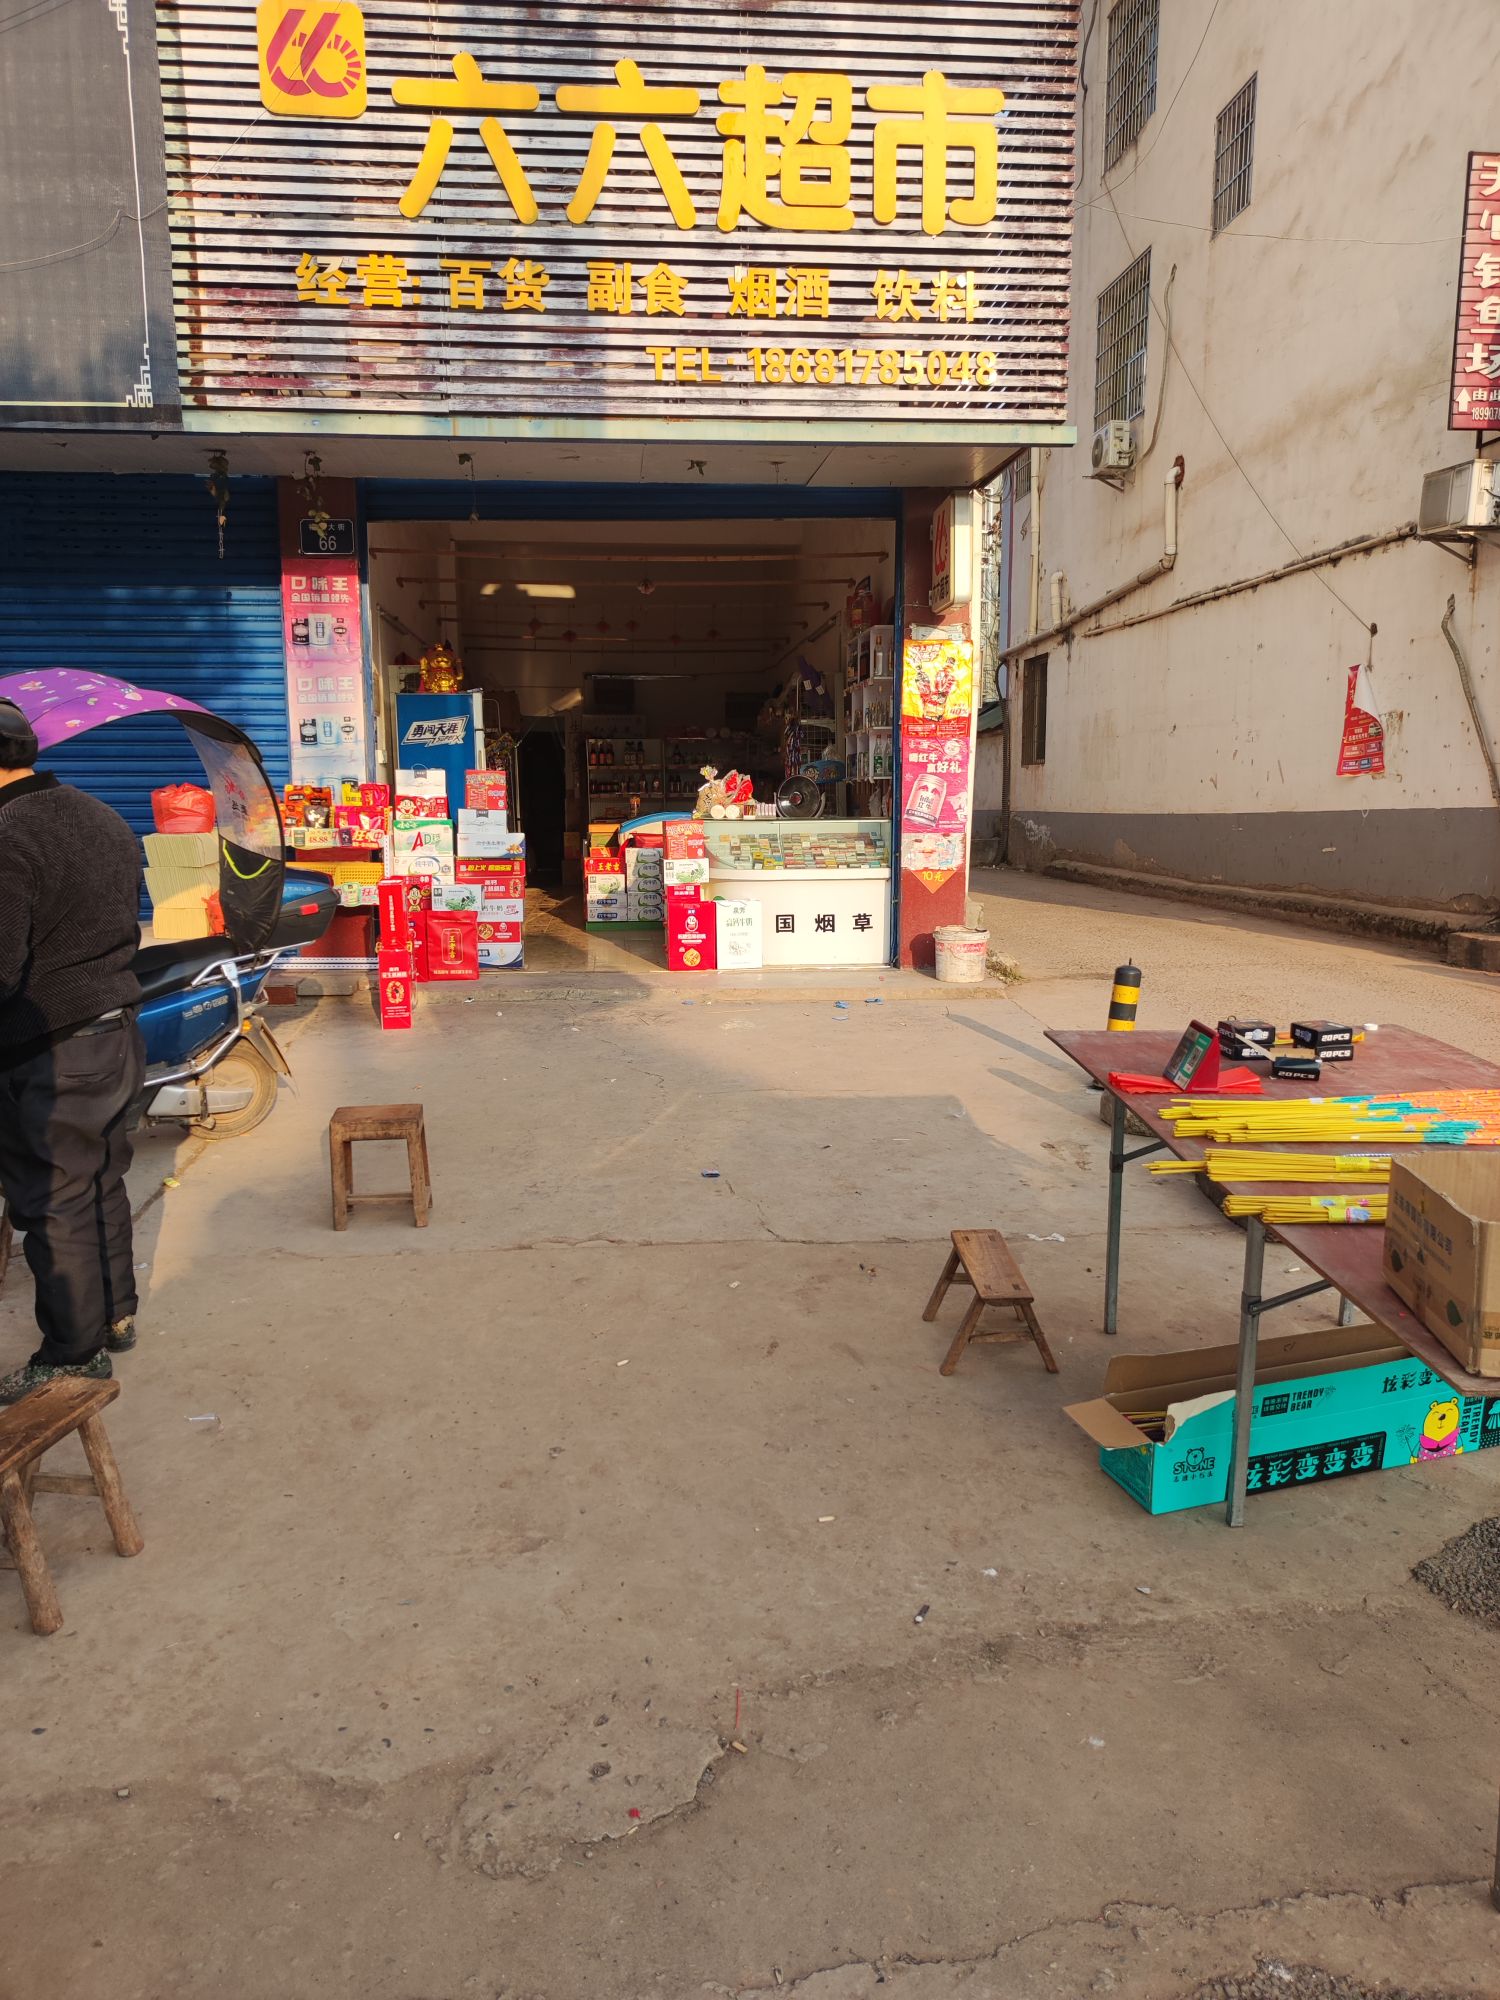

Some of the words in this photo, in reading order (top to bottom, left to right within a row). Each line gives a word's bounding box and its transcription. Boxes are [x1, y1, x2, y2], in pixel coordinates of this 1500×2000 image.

[391, 52, 1004, 236] 六六超市
[440, 257, 550, 313] 百货
[586, 261, 689, 317] 副食
[728, 265, 831, 320] 烟酒
[871, 269, 980, 323] 饮料
[747, 348, 998, 386] 18681785048
[319, 535, 337, 551] 66
[291, 576, 349, 591] 口味王
[297, 676, 355, 691] 口味王
[597, 861, 620, 872] 王老吉
[775, 912, 873, 933] 国烟草
[1292, 1387, 1325, 1401] TRENDY
[1290, 1400, 1313, 1412] BEAR
[1460, 1406, 1471, 1434] BEAR
[1469, 1404, 1481, 1443] TRENDY
